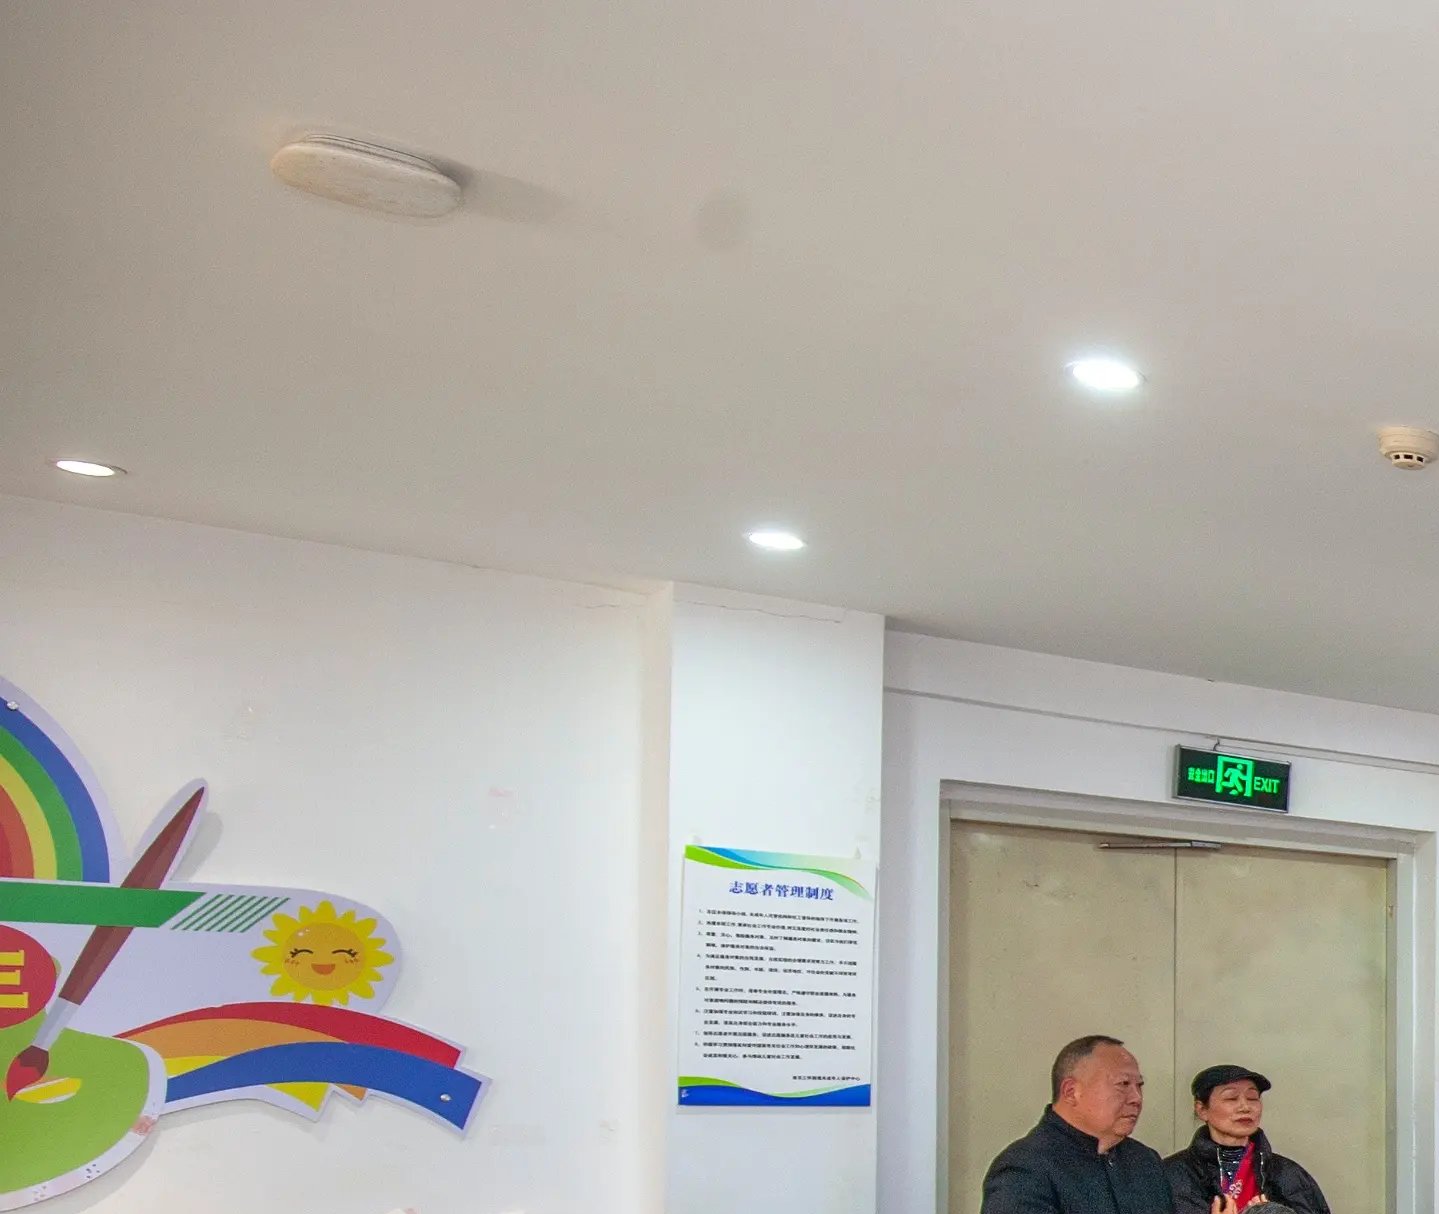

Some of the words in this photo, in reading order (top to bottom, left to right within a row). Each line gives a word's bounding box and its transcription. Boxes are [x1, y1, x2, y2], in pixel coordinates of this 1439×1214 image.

[1253, 776, 1280, 793] EXIT
[729, 881, 834, 900] 志愿者管理制度
